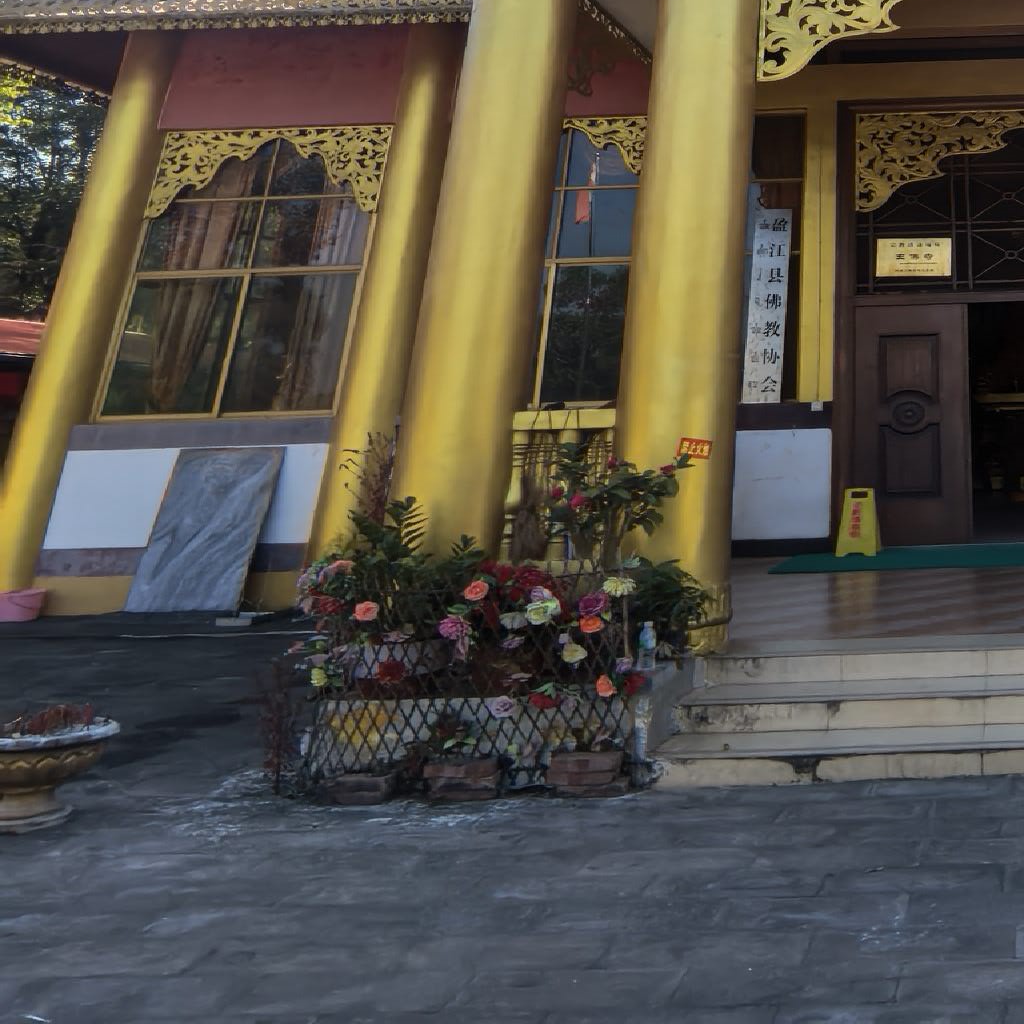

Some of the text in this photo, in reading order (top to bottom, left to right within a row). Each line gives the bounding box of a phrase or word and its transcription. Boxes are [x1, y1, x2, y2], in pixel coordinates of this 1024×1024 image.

[760, 217, 788, 393] 盈江县佛教协会
